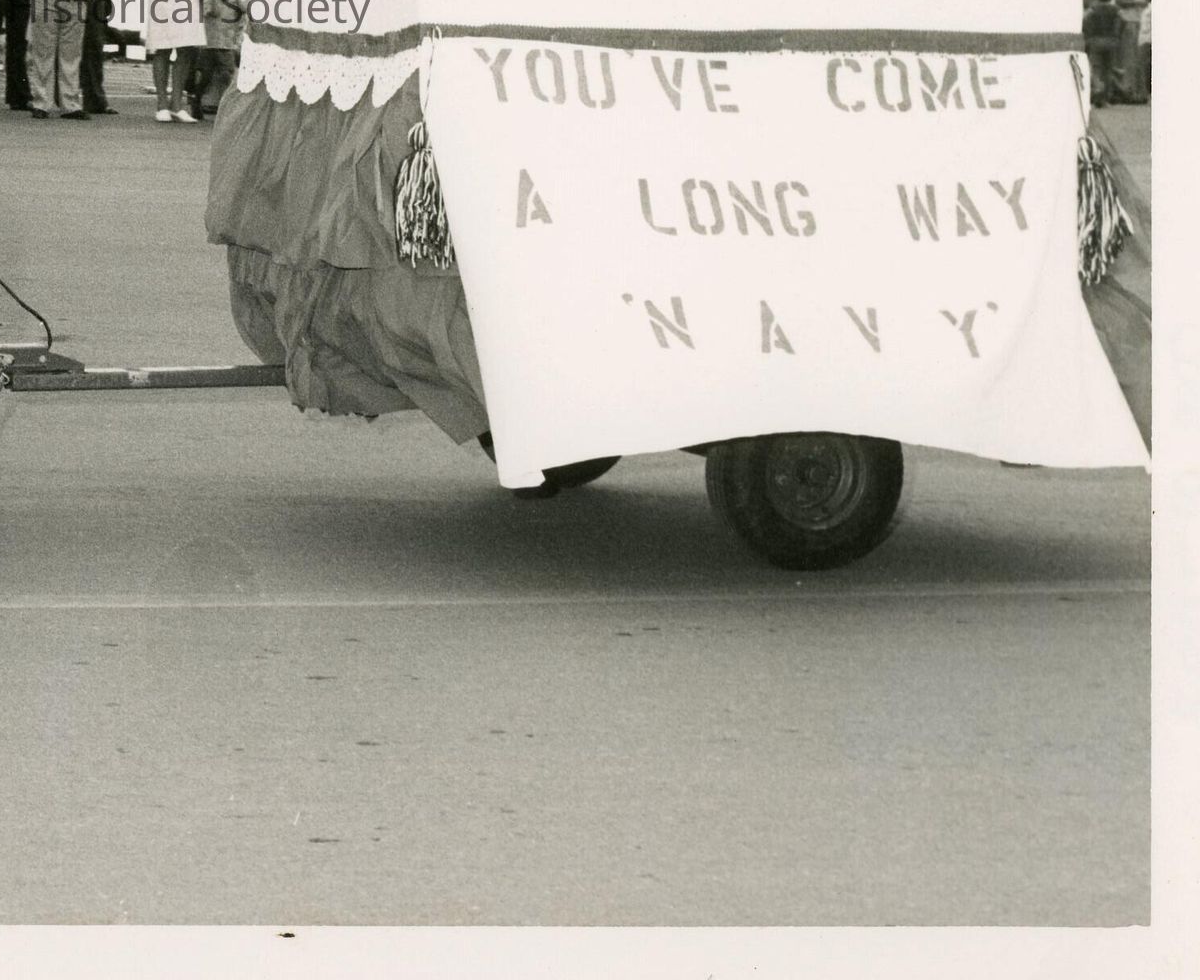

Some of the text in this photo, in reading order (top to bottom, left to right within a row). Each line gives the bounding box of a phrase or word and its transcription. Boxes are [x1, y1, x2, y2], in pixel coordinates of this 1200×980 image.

[473, 48, 1007, 113] YOU'VE COME
[515, 169, 1030, 242] A LONG WAY
